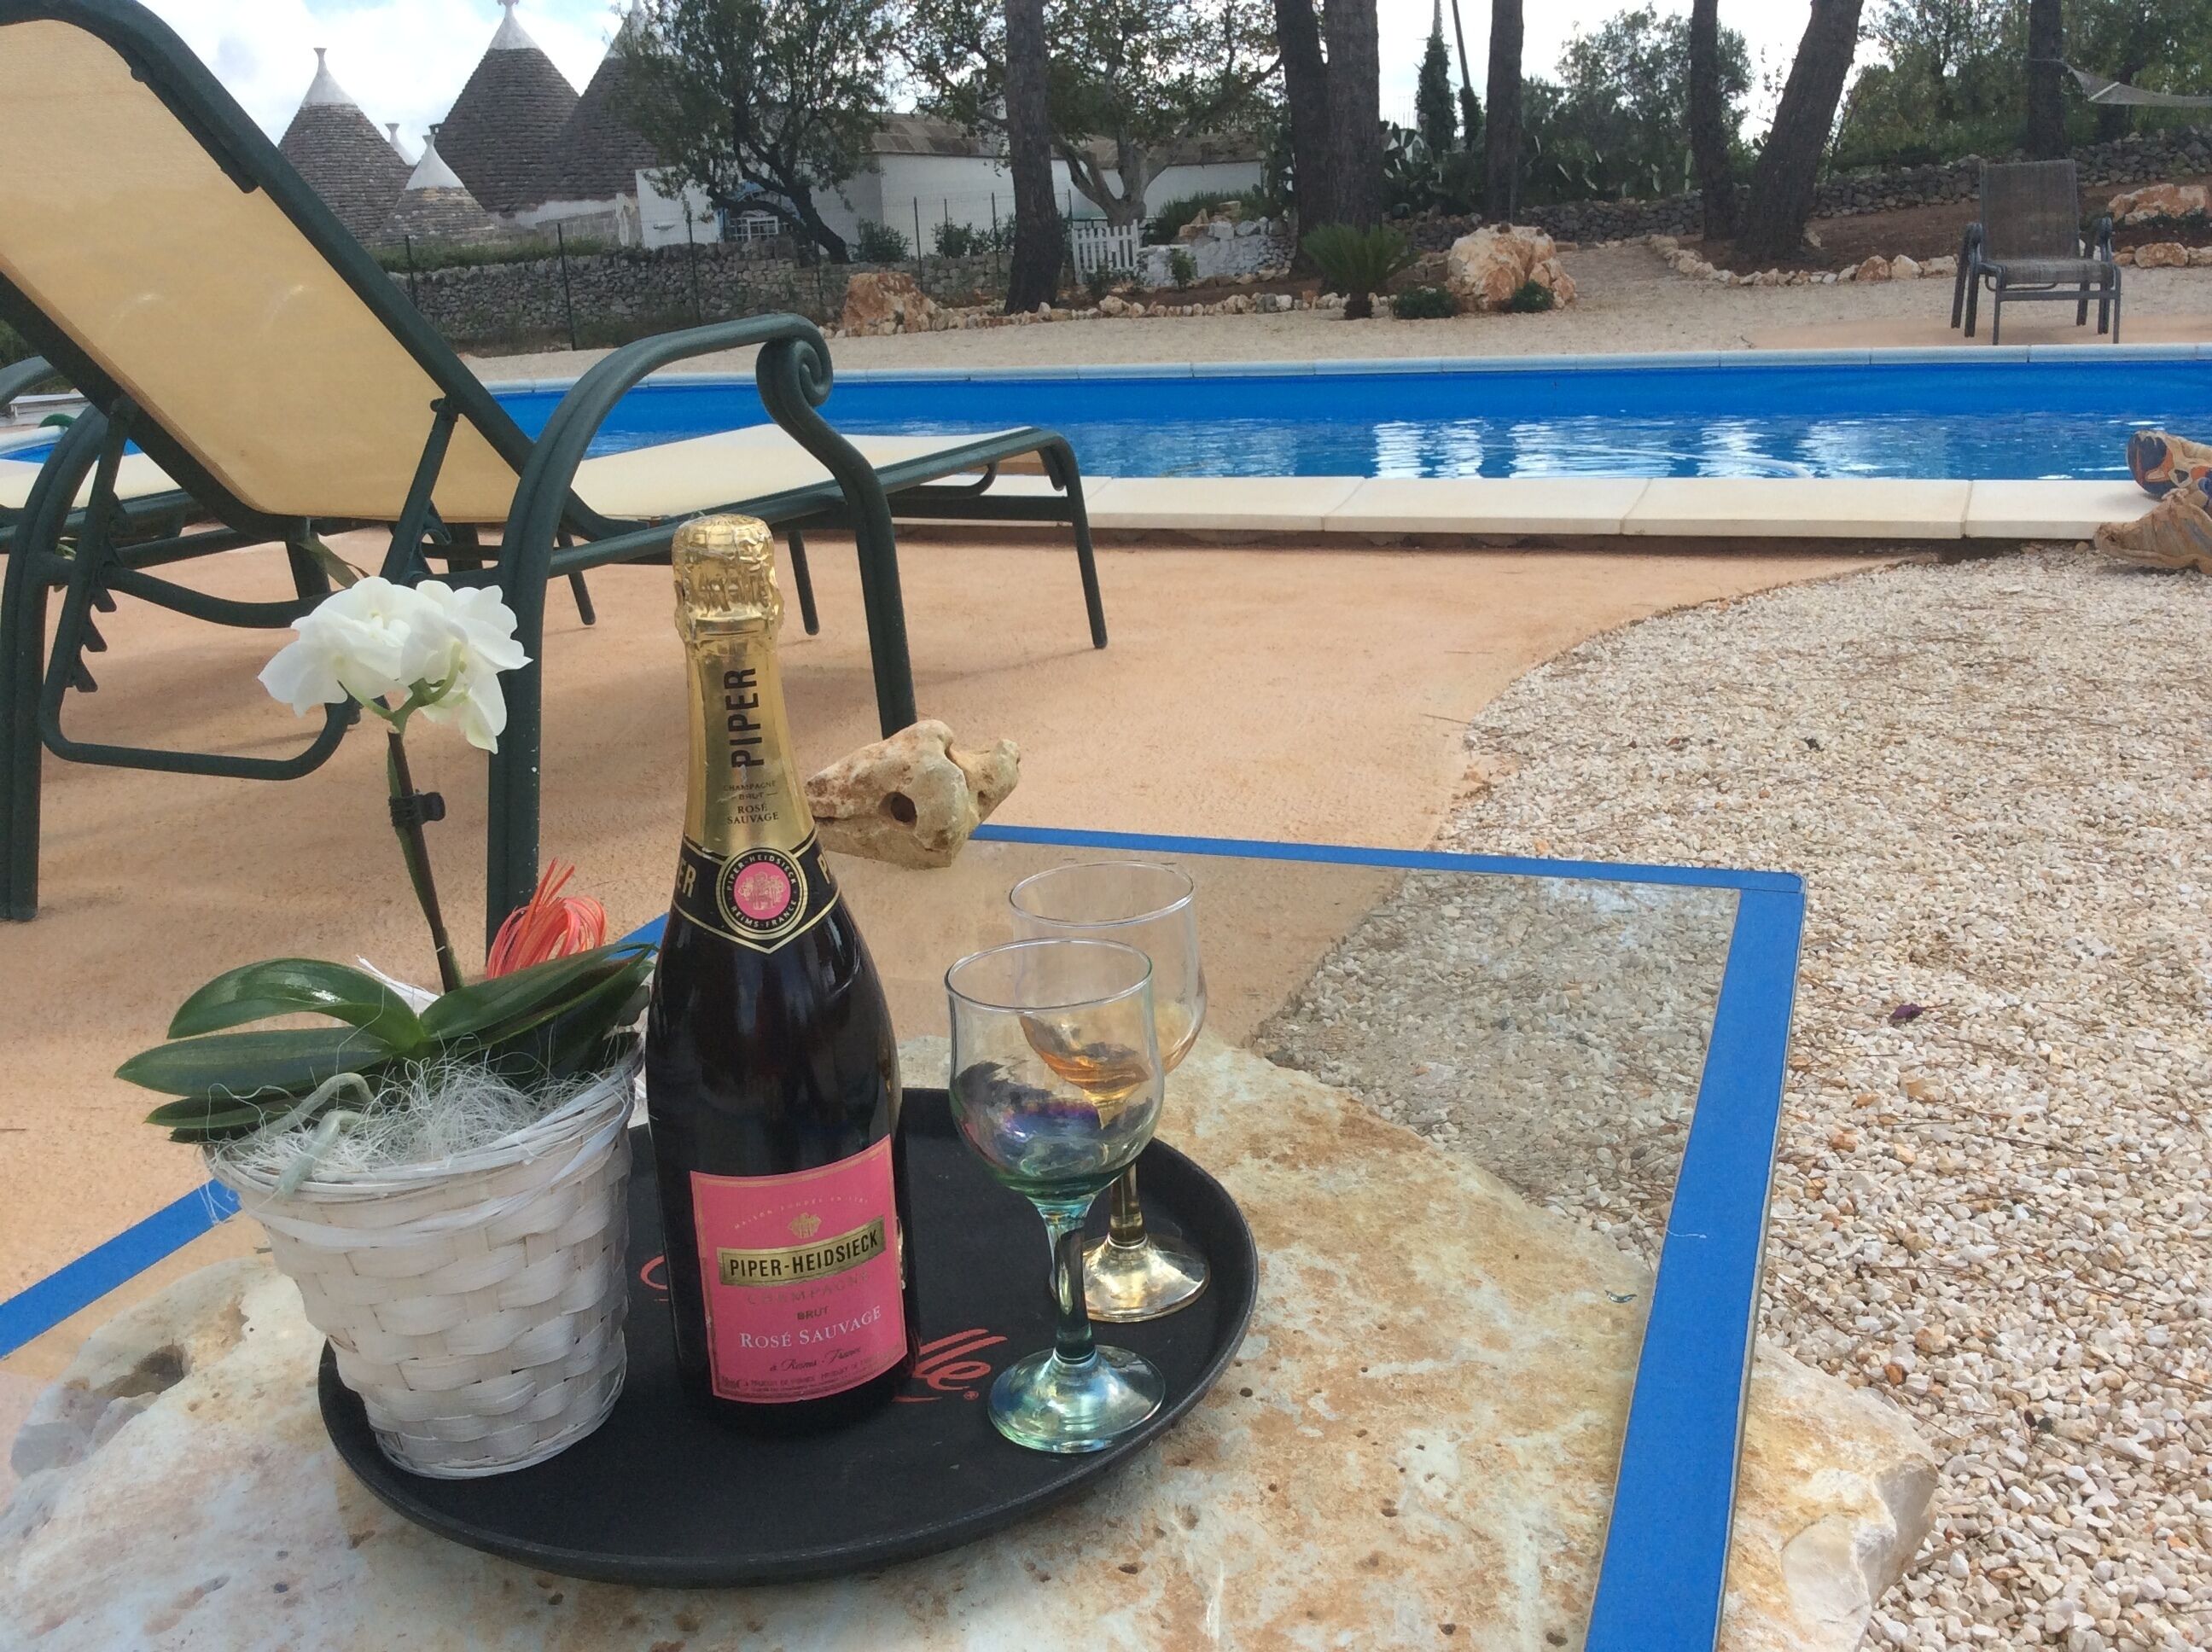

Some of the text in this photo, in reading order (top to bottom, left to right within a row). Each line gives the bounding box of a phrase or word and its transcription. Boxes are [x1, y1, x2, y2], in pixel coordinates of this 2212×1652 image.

[724, 667, 765, 768] PIPER
[723, 779, 777, 792] CHAMPAGNE
[738, 792, 765, 800] BRUT
[736, 801, 768, 814] ROSÉ
[726, 811, 780, 825] SAUVAGE
[730, 1229, 879, 1277] PIPER-HEIDSIECK
[747, 1271, 870, 1305] CHAMPAGNE
[796, 1306, 830, 1320] BRUT
